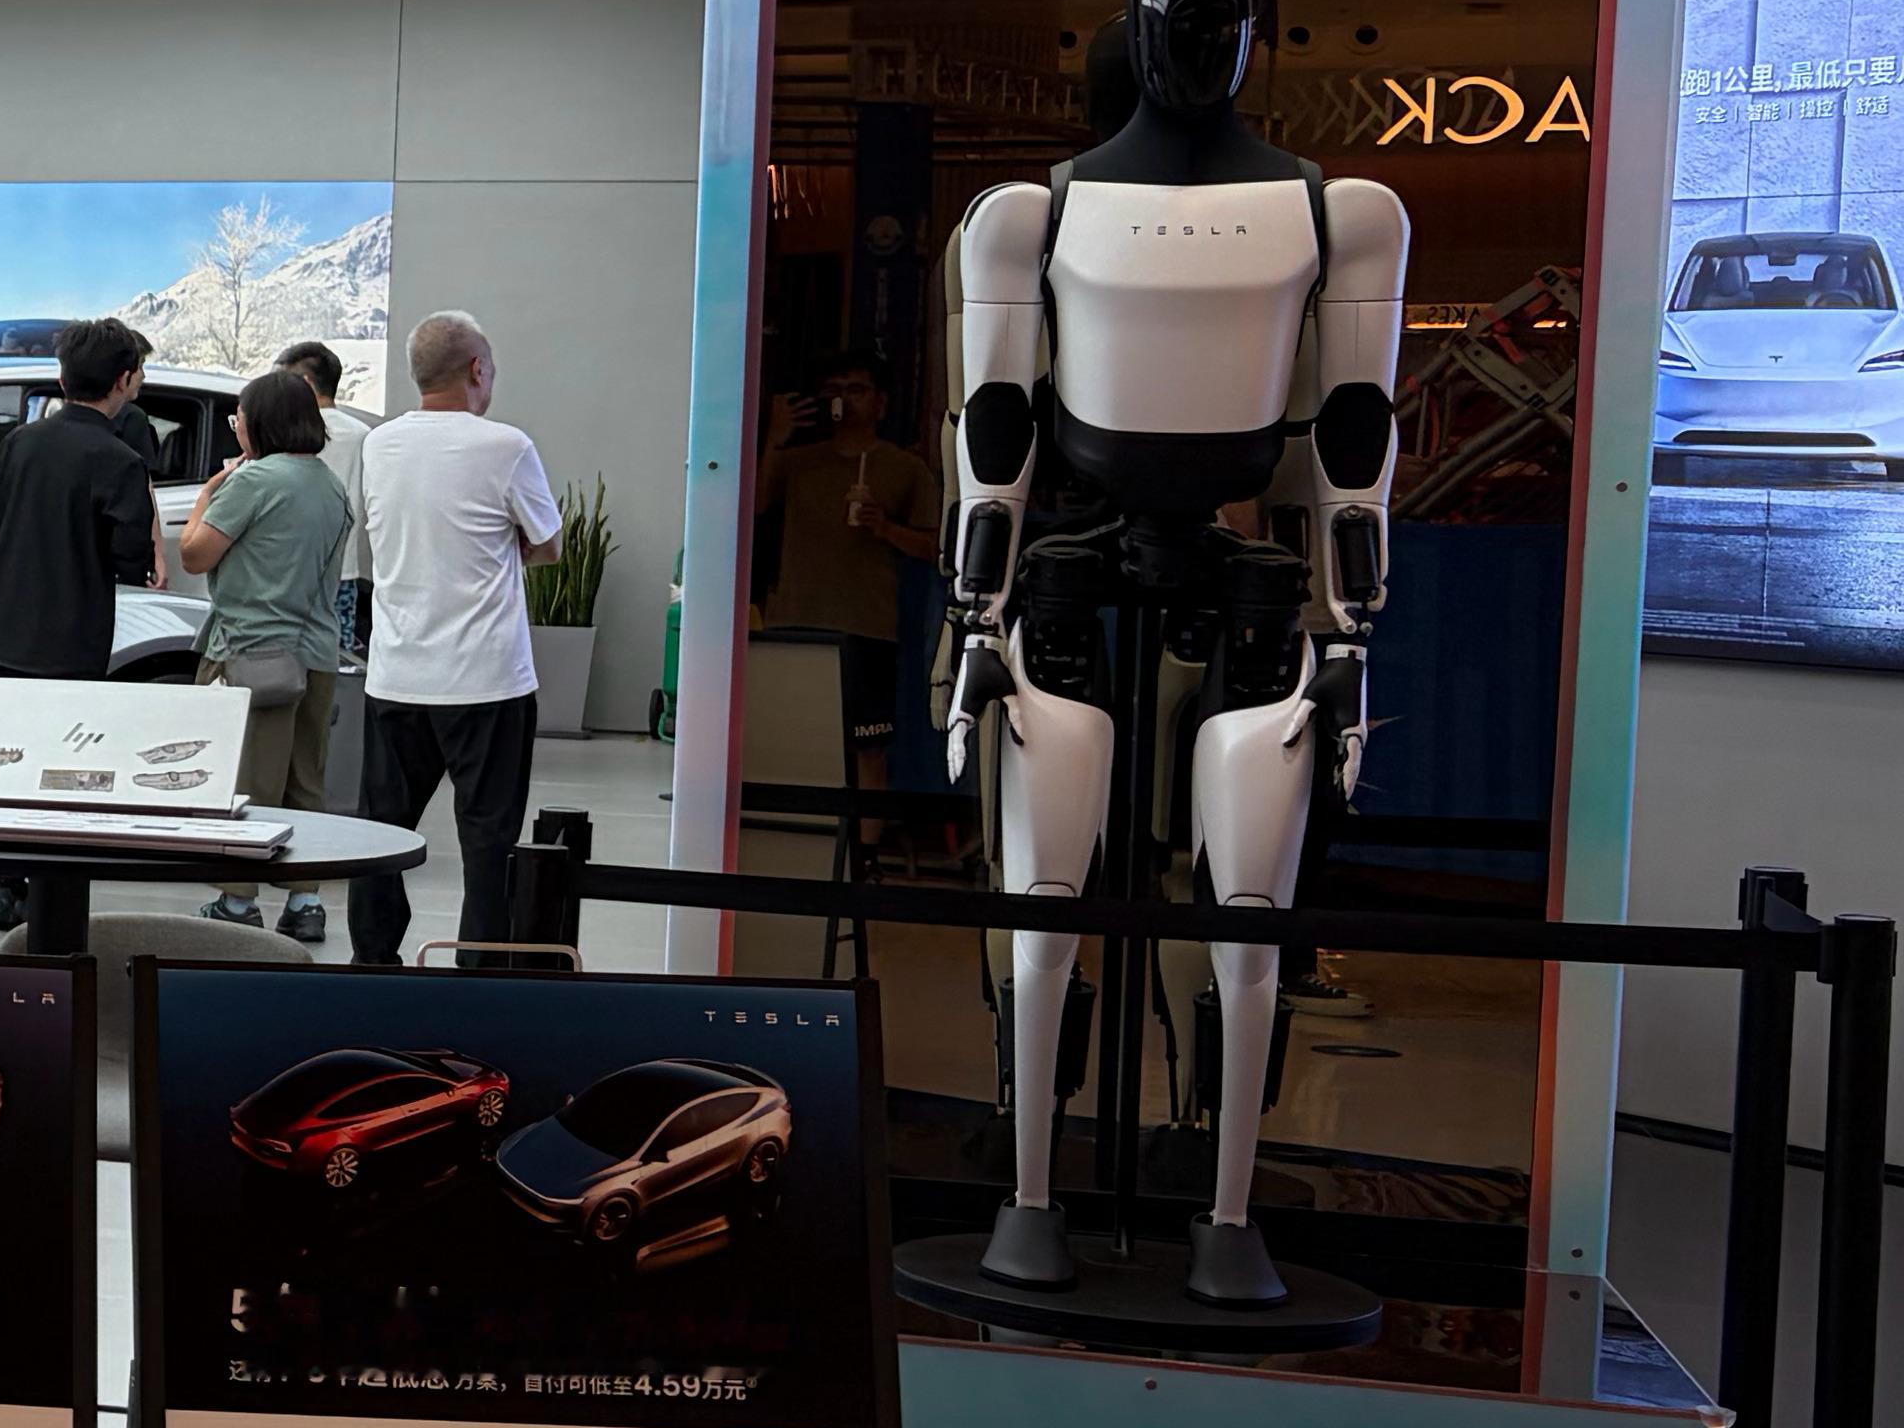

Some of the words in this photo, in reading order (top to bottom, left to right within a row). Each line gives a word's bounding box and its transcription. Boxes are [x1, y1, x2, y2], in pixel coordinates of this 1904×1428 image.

[1696, 107, 1727, 124] 安全
[1747, 103, 1780, 122] 智能
[1800, 99, 1834, 119] 操控
[1856, 96, 1889, 115] 舒适
[1131, 226, 1247, 236] TESLA
[704, 1010, 840, 1026] TESLA
